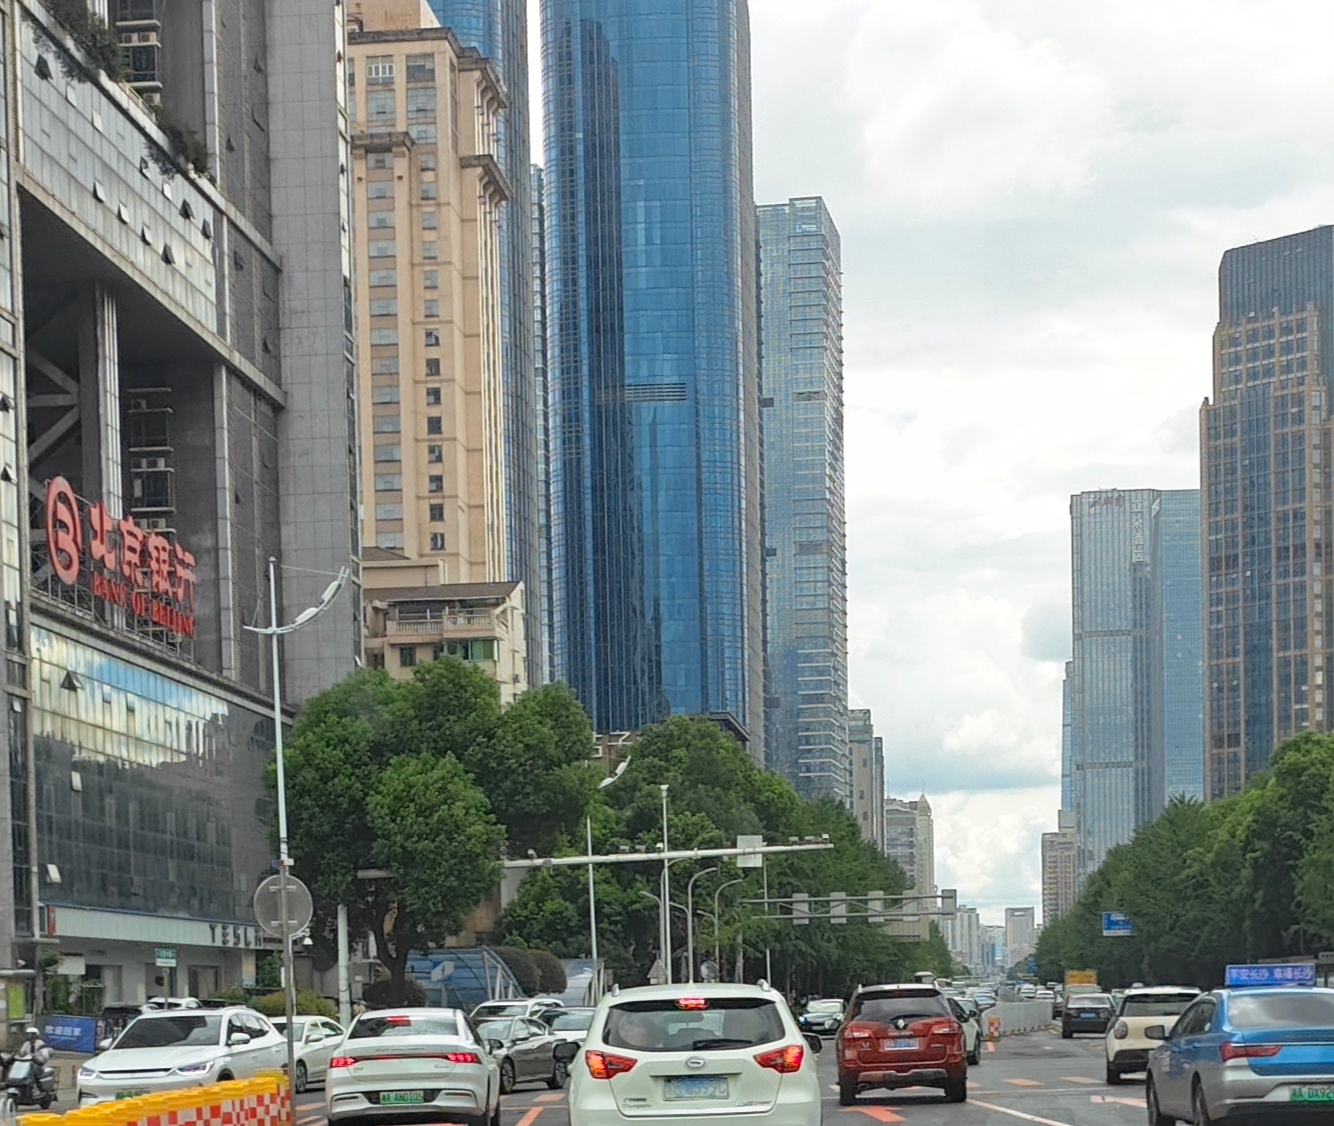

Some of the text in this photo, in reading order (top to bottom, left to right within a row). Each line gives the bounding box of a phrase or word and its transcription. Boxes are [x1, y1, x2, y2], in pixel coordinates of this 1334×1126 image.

[89, 501, 197, 613] 北京银行
[92, 573, 128, 608] BANK
[132, 591, 148, 617] OF
